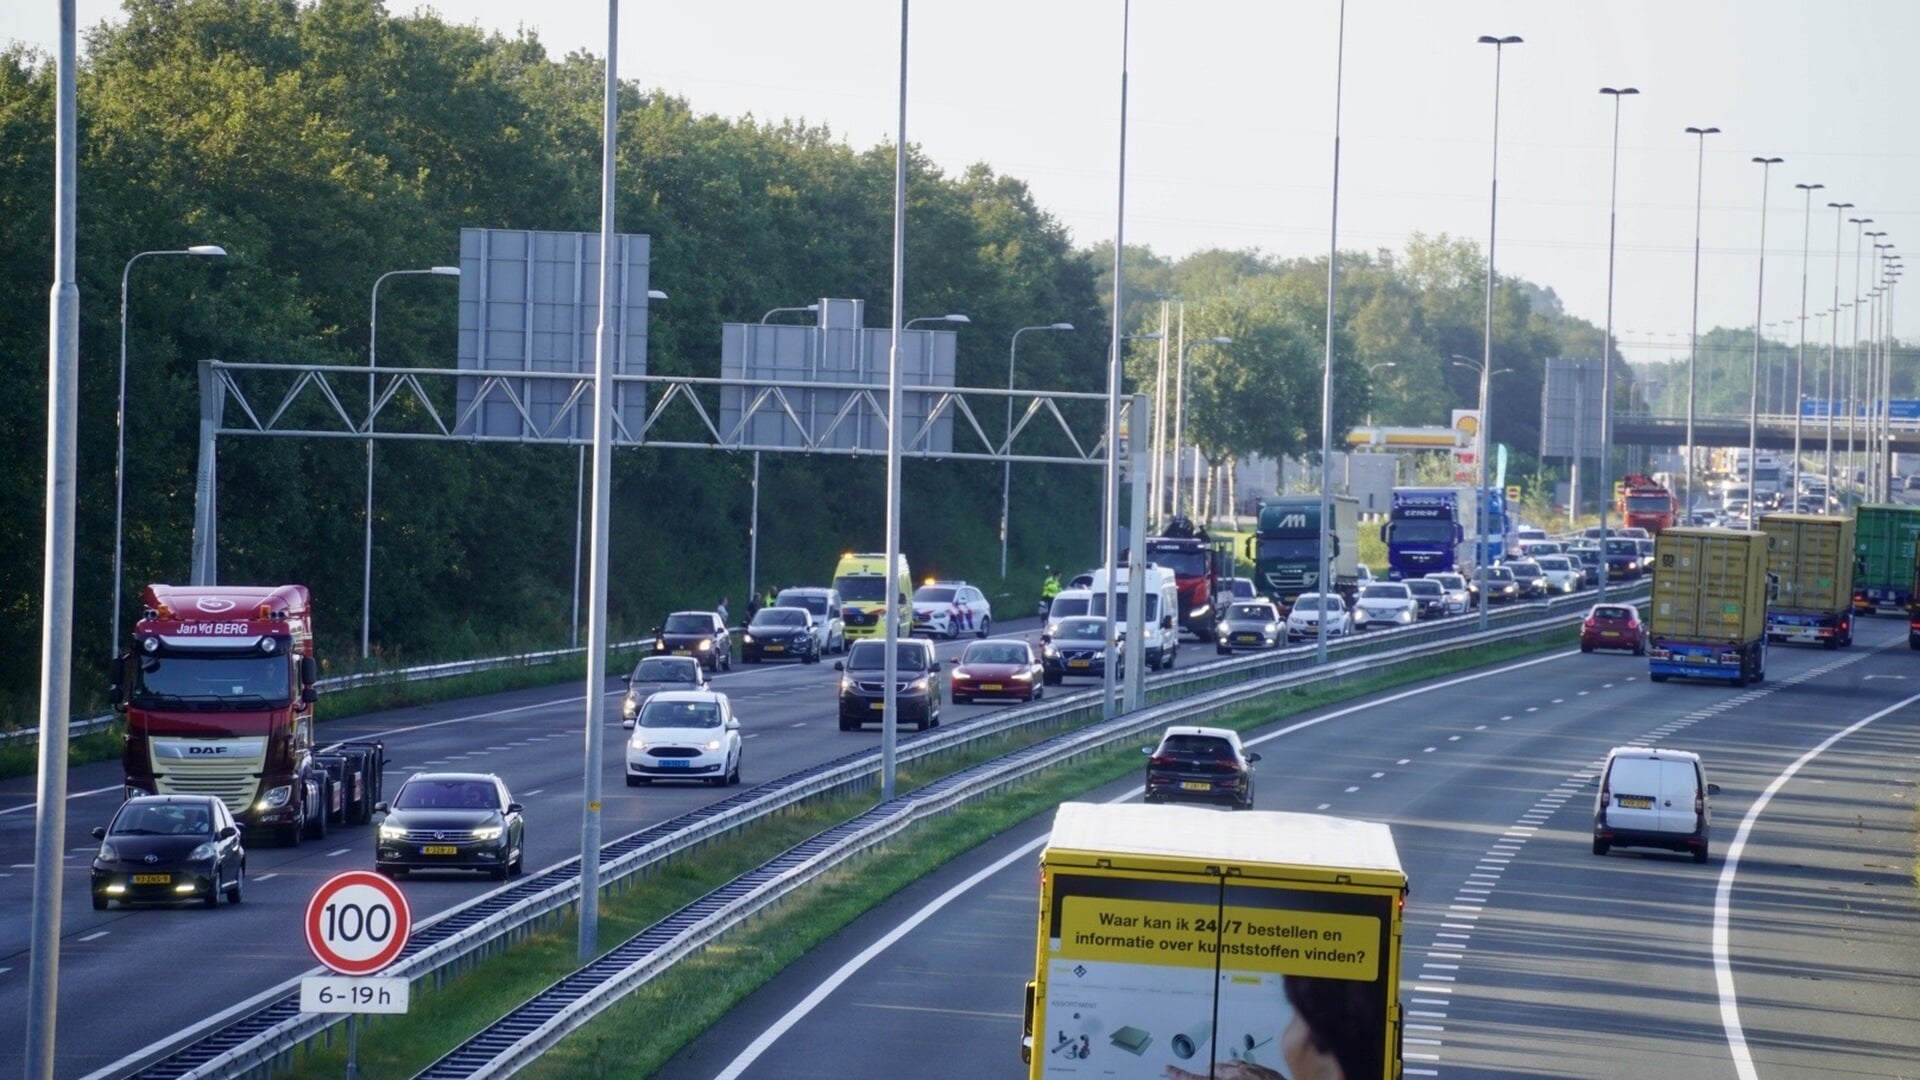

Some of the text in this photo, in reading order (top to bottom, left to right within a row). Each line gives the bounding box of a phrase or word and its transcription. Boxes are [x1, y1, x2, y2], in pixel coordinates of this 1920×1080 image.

[177, 623, 197, 634] Jan
[213, 623, 248, 634] BERG
[189, 746, 227, 754] DAF
[326, 903, 391, 942] 100
[1099, 912, 1139, 927] Waar
[1143, 916, 1171, 930] kan
[1176, 918, 1189, 931] ik
[1247, 922, 1318, 940] bestellen
[1323, 930, 1342, 941] en
[1075, 931, 1365, 963] informatie over kunststoffen vinden?
